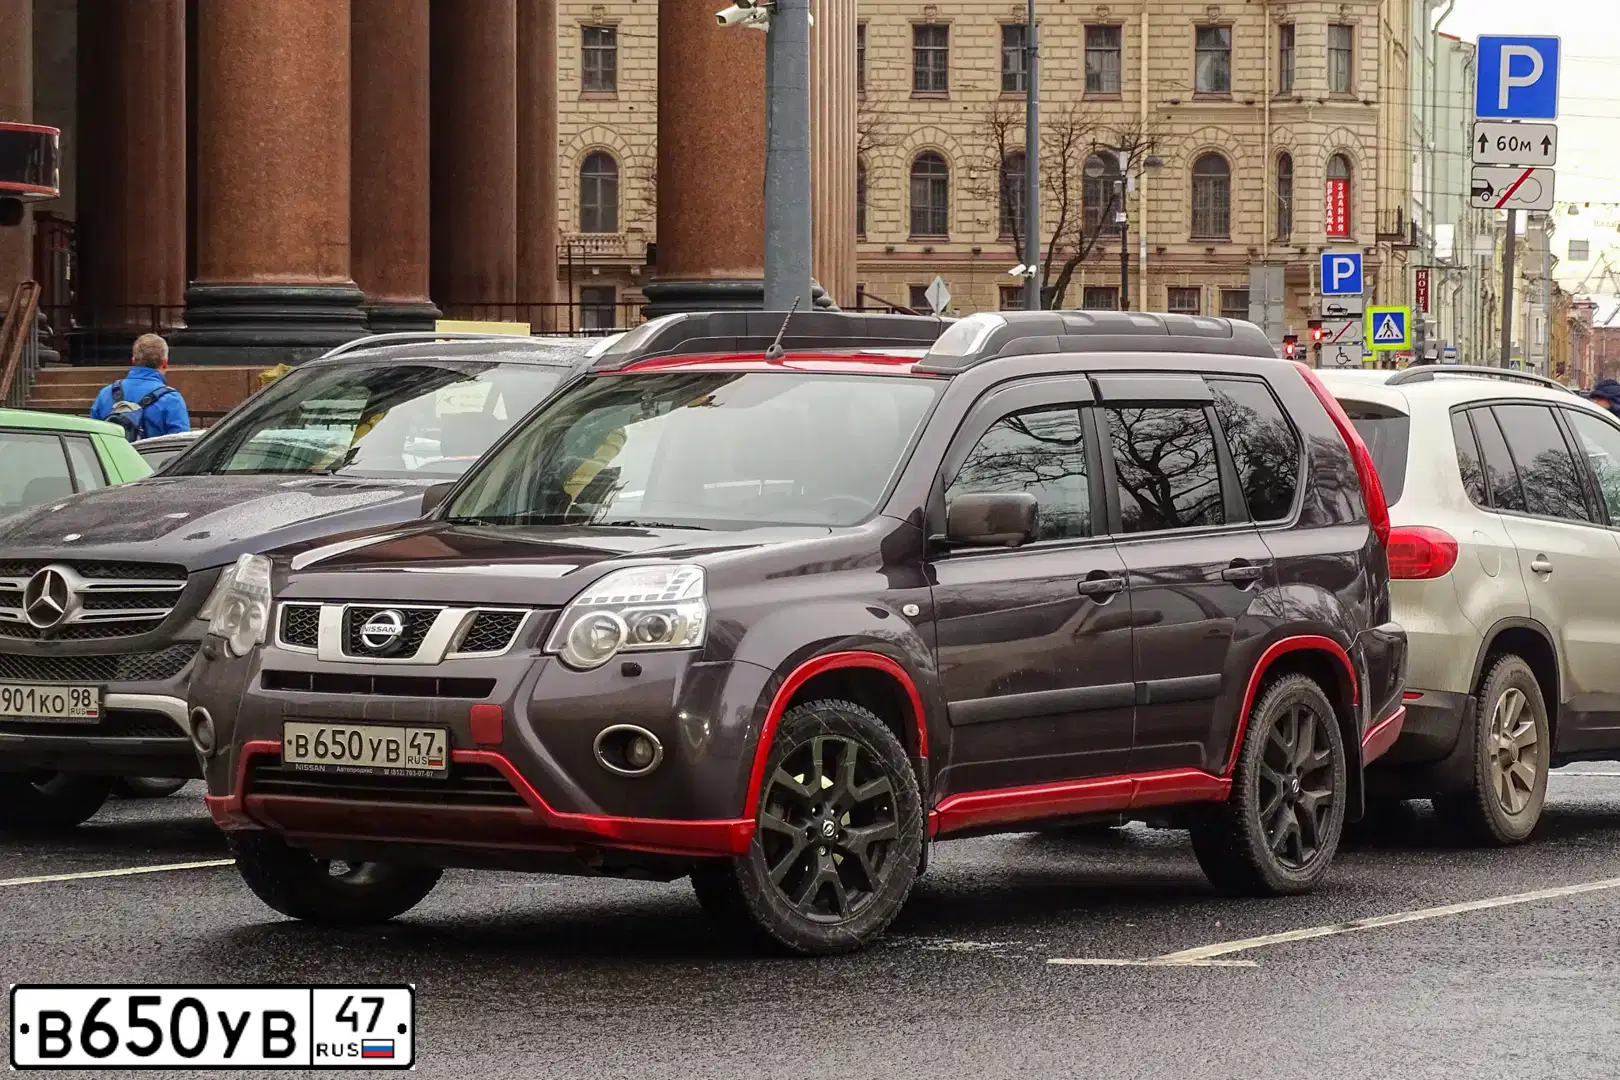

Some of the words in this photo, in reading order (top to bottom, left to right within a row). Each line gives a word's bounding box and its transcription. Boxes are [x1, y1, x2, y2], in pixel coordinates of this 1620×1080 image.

[1498, 45, 1544, 110] P
[1326, 181, 1334, 232] ПРОДАЖА
[1332, 257, 1356, 290] P
[362, 625, 397, 634] NISSAN
[71, 688, 92, 708] 98
[70, 707, 87, 716] RUS
[295, 728, 401, 763] В650УВ
[409, 731, 436, 756] 47
[295, 763, 326, 773] NISSAN
[407, 755, 428, 765] RUS
